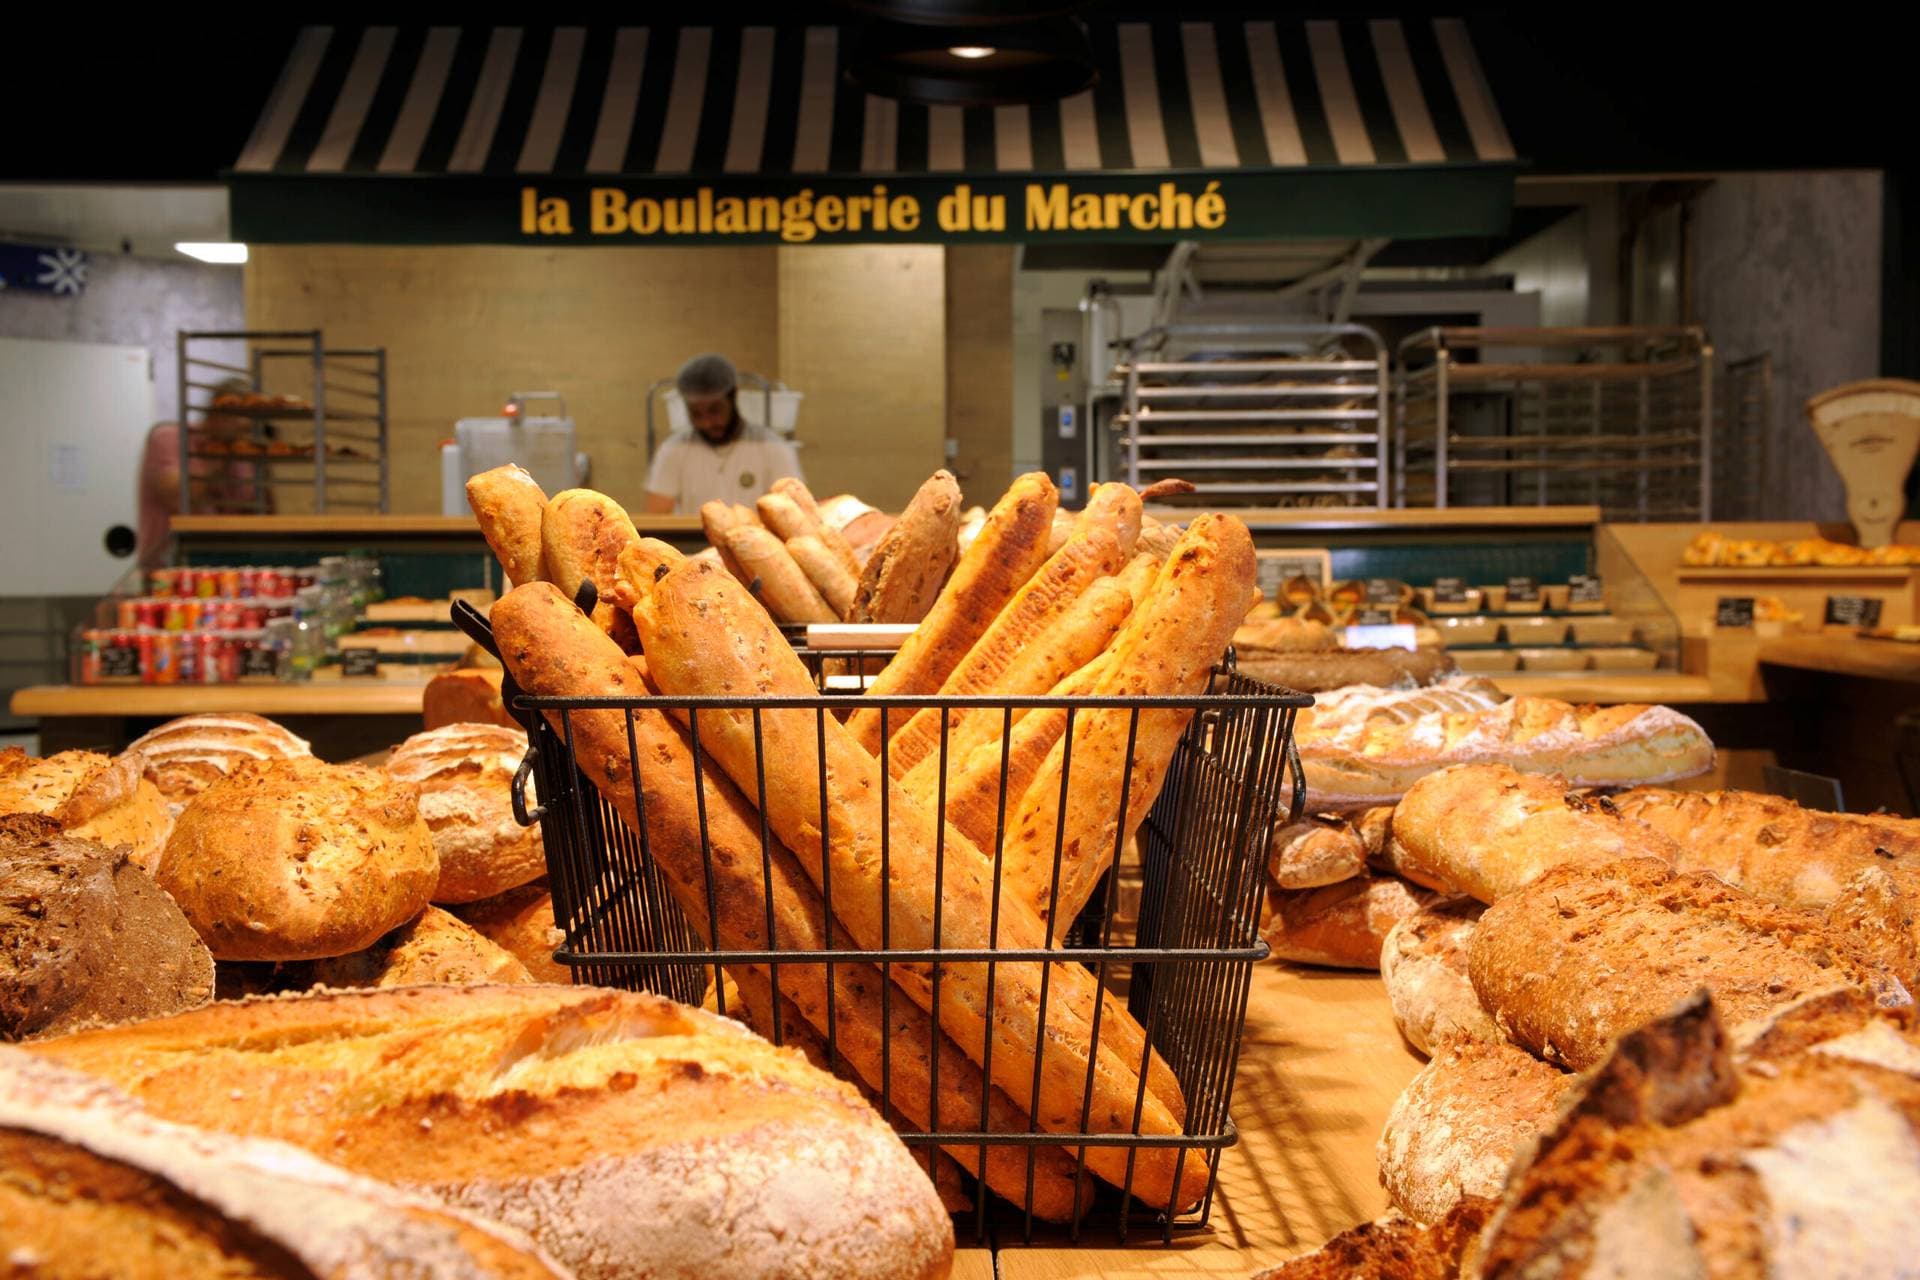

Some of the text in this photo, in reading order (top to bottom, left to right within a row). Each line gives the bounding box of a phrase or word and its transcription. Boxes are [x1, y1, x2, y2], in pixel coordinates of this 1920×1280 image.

[521, 180, 1227, 242] la Boulangerie du Marché
